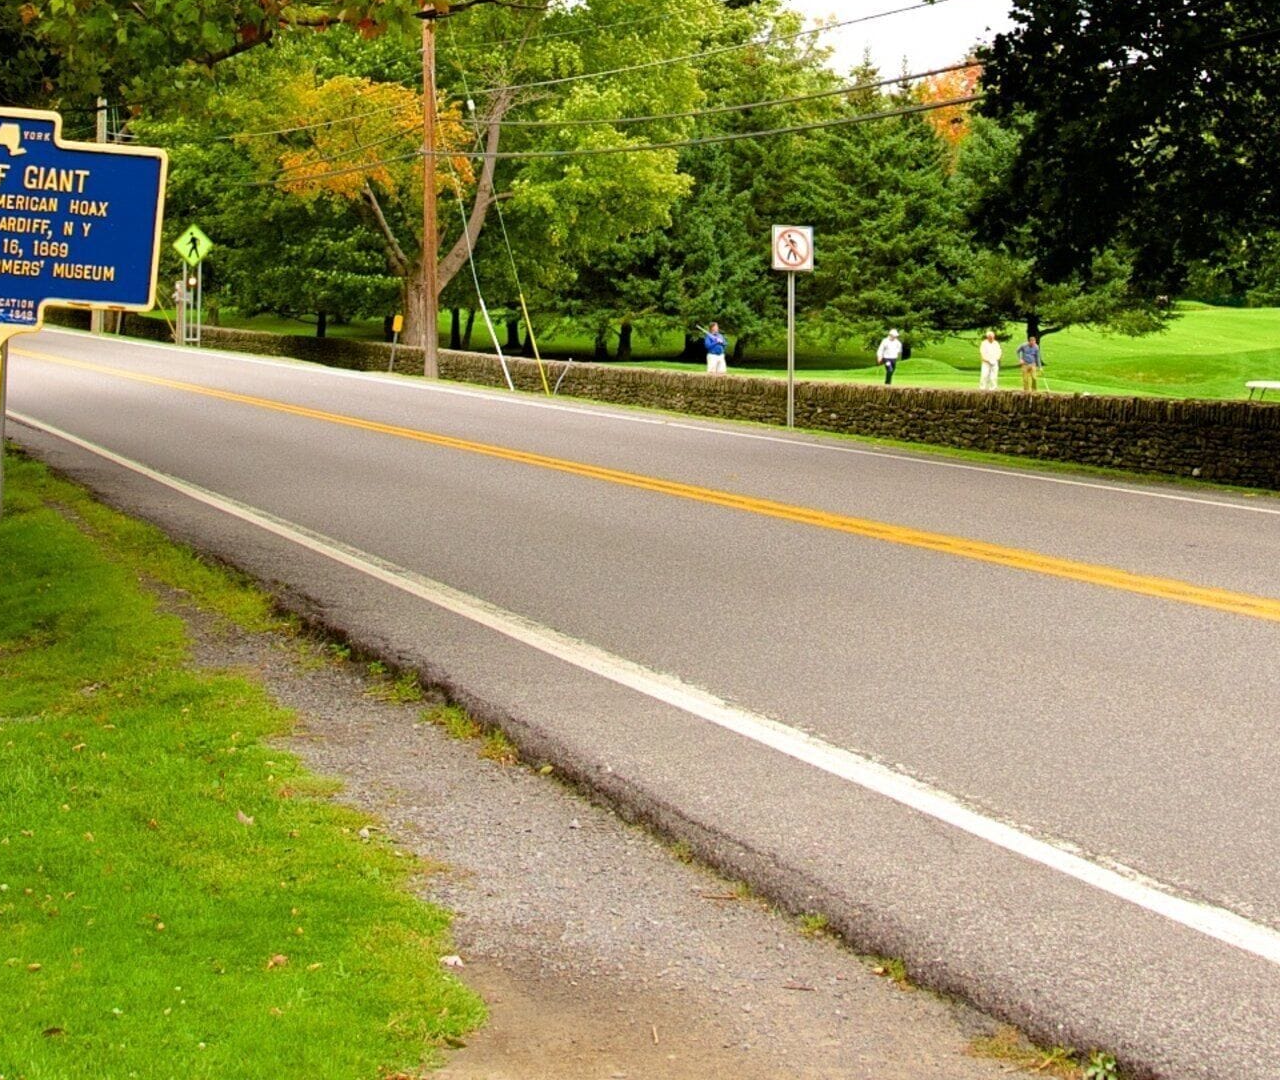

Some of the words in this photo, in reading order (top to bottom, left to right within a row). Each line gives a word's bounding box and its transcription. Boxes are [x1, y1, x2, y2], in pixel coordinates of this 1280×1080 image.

[23, 130, 51, 141] YORK
[23, 165, 90, 194] GIANT
[69, 199, 109, 218] HOAX
[63, 221, 74, 236] N
[81, 222, 92, 237] Y
[2, 238, 23, 258] 16,
[33, 240, 69, 258] 1869
[52, 262, 115, 282] MUSEUM
